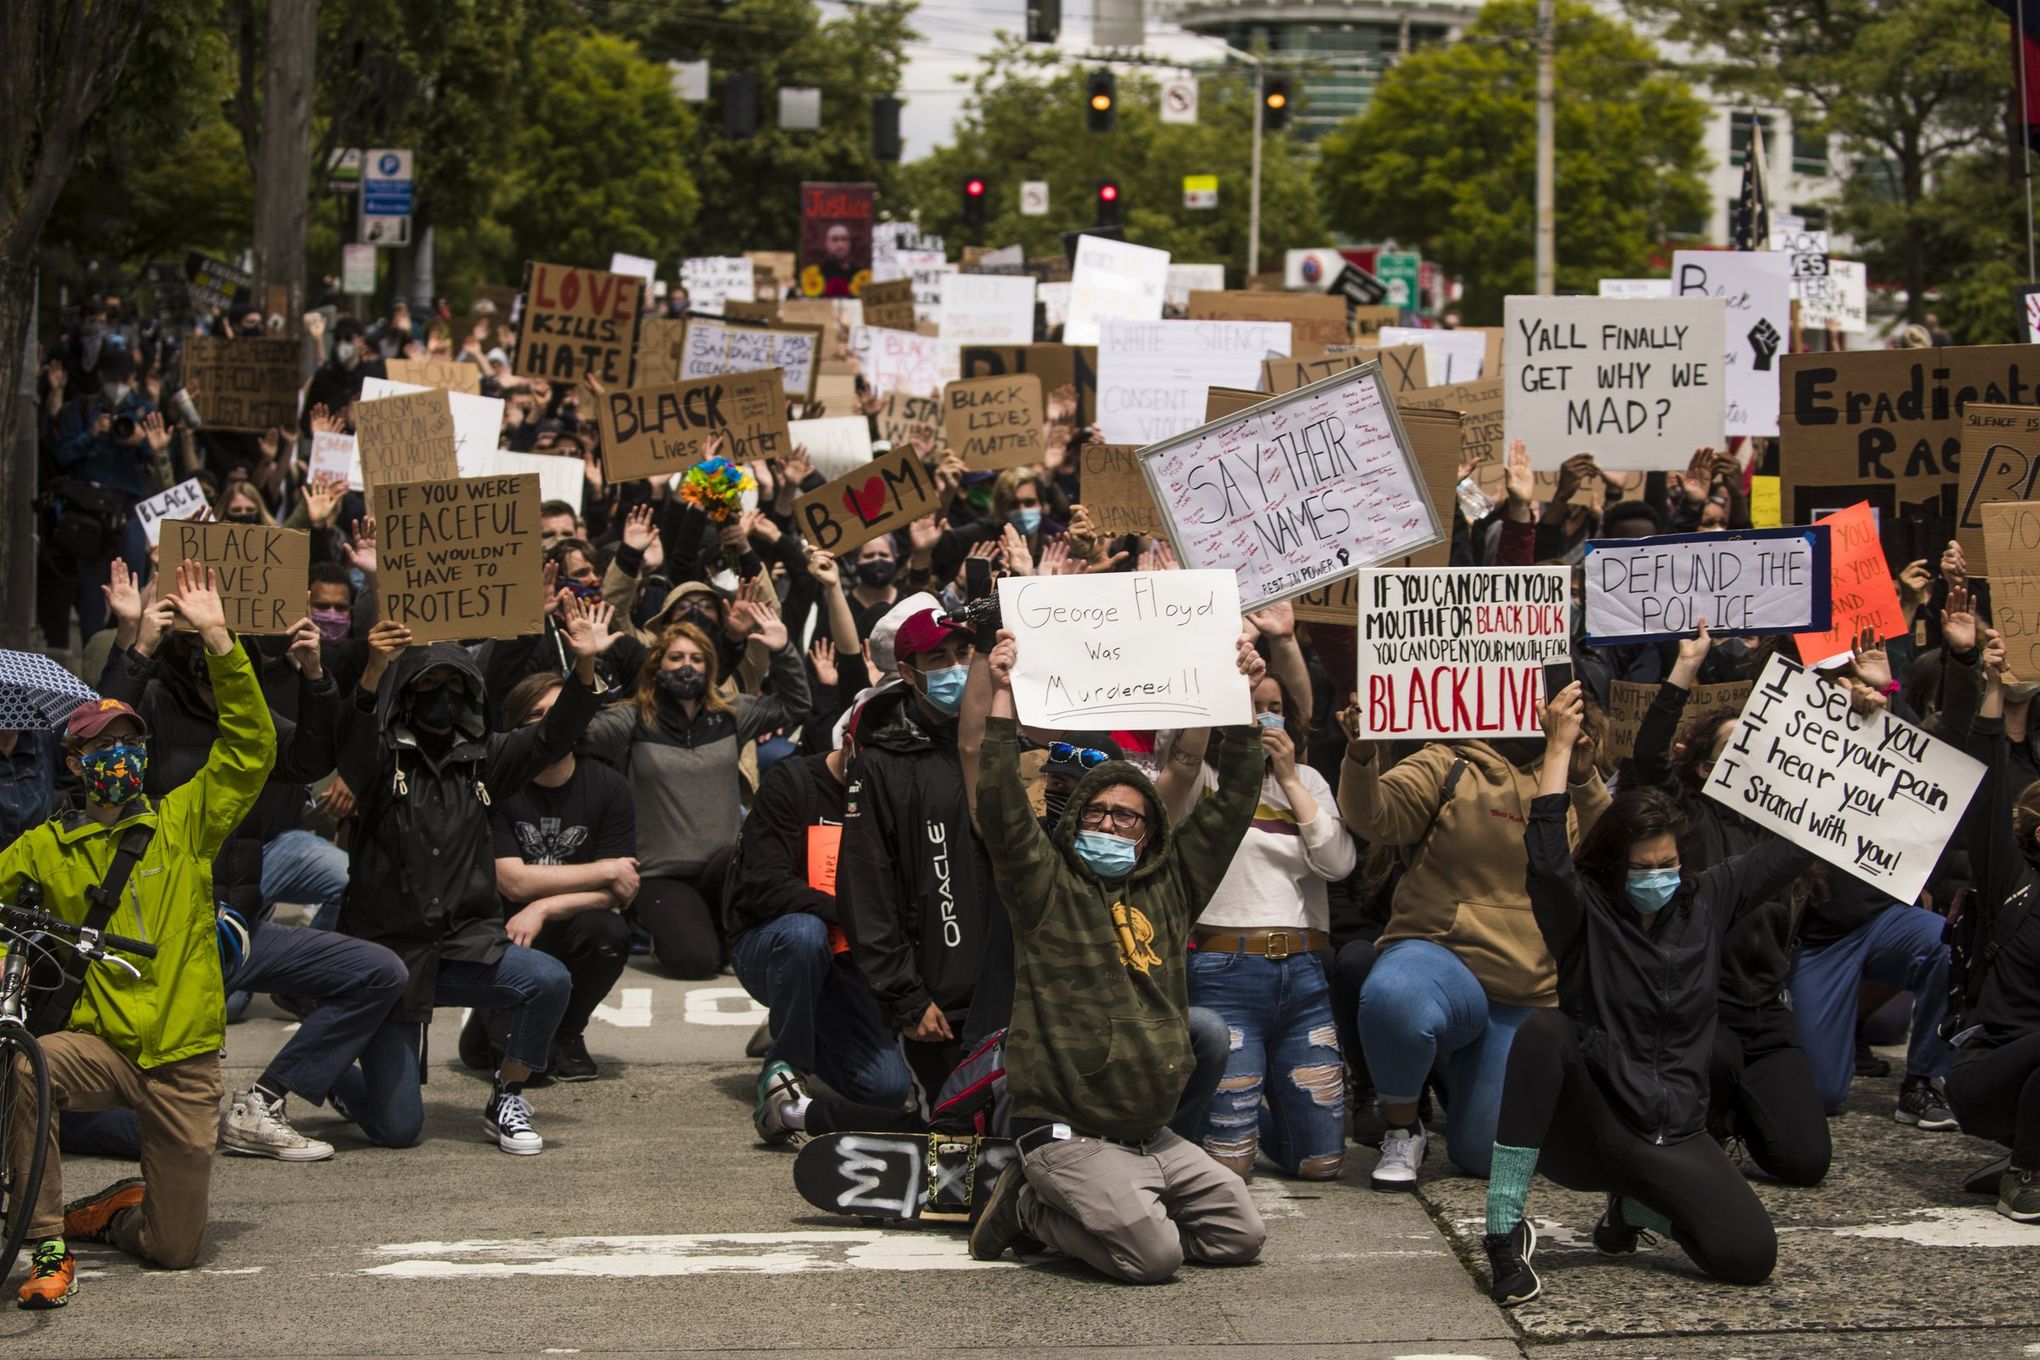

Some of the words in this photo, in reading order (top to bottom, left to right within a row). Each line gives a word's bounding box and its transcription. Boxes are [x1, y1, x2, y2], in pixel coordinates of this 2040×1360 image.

[1783, 232, 1823, 250] ACK
[536, 266, 637, 321] LOVE
[1795, 277, 1829, 298] TER
[532, 314, 616, 342] KILLS
[1109, 325, 1165, 351] WHITE
[1195, 323, 1270, 351] SILENCE
[1519, 318, 1587, 356] YALL
[1602, 324, 1688, 350] FINALLY
[404, 361, 463, 385] HOW
[526, 342, 623, 383] HATE
[1521, 365, 1573, 393] GET
[1598, 362, 1651, 389] WHY
[1672, 363, 1708, 388] WE
[357, 397, 412, 421] RACISM
[609, 383, 727, 443] BLACK
[952, 386, 1024, 409] BLACK
[1104, 385, 1188, 413] CONSENT
[362, 416, 428, 446] AMERICAN
[968, 408, 1031, 431] LIVES
[1567, 397, 1672, 436] MAD?
[1968, 414, 2017, 427] SILENCE
[650, 434, 698, 460] Lives
[962, 428, 1040, 459] MATTER
[1086, 447, 1133, 473] CAN
[1188, 444, 1269, 525] SAY
[1272, 416, 1358, 491] THEIR
[140, 484, 199, 522] BLACK
[388, 488, 408, 510] IF
[422, 485, 458, 505] YOU
[467, 478, 521, 500] WERE
[805, 457, 926, 550] BLM
[386, 501, 529, 549] PEACEFUL
[1087, 504, 1160, 531] CHANGE
[1253, 490, 1350, 560] NAMES
[2001, 510, 2040, 550] YO
[180, 526, 283, 564] BLACK
[383, 552, 416, 571] WE
[428, 542, 523, 566] WOULDN'T
[406, 566, 461, 589] HAVE
[475, 562, 497, 578] TO
[1262, 576, 1284, 597] REST
[1287, 570, 1302, 587] IN
[1301, 558, 1337, 582] POWER
[1602, 552, 1742, 595] DEFUND
[1757, 551, 1805, 587] THE
[387, 583, 518, 623] PROTEST
[1016, 581, 1120, 629] George
[1133, 576, 1214, 627] Floyd
[1374, 574, 1394, 608] IF
[1397, 574, 1429, 606] YOU
[1432, 573, 1472, 606] CAN
[1472, 573, 1520, 604] OPEN
[1521, 573, 1563, 604] YOUR
[1831, 593, 1864, 617] AND
[220, 597, 288, 629] TTER
[1366, 608, 1436, 640] MOUTH
[1436, 606, 1472, 638] FOR
[1477, 605, 1523, 635] BLACK
[1527, 605, 1564, 636] DICK
[1642, 594, 1755, 633] POLICE
[1084, 641, 1121, 661] Was
[1373, 643, 1397, 665] YOU
[1400, 639, 1428, 662] CAN
[1429, 639, 1471, 662] OPEN
[1471, 640, 1503, 663] YOUR
[1504, 639, 1543, 662] MOUTH
[1545, 638, 1567, 656] FOR
[1369, 666, 1473, 733] BLACK
[1476, 666, 1544, 732] LIVE
[1612, 685, 1657, 707] NOTHIN
[1717, 688, 1731, 703] GO
[1765, 657, 1804, 698] I
[1877, 715, 1931, 764] you
[1612, 707, 1625, 722] TO
[1749, 690, 1783, 724] I
[1836, 737, 1896, 778] your
[1733, 720, 1762, 755] I
[1767, 737, 1836, 789] hear
[1837, 782, 1885, 817] you
[1715, 758, 1741, 789] I
[1808, 811, 1848, 847] with
[1853, 835, 1902, 877] you!
[820, 855, 837, 888] Lives
[929, 821, 961, 948] ORACLE
